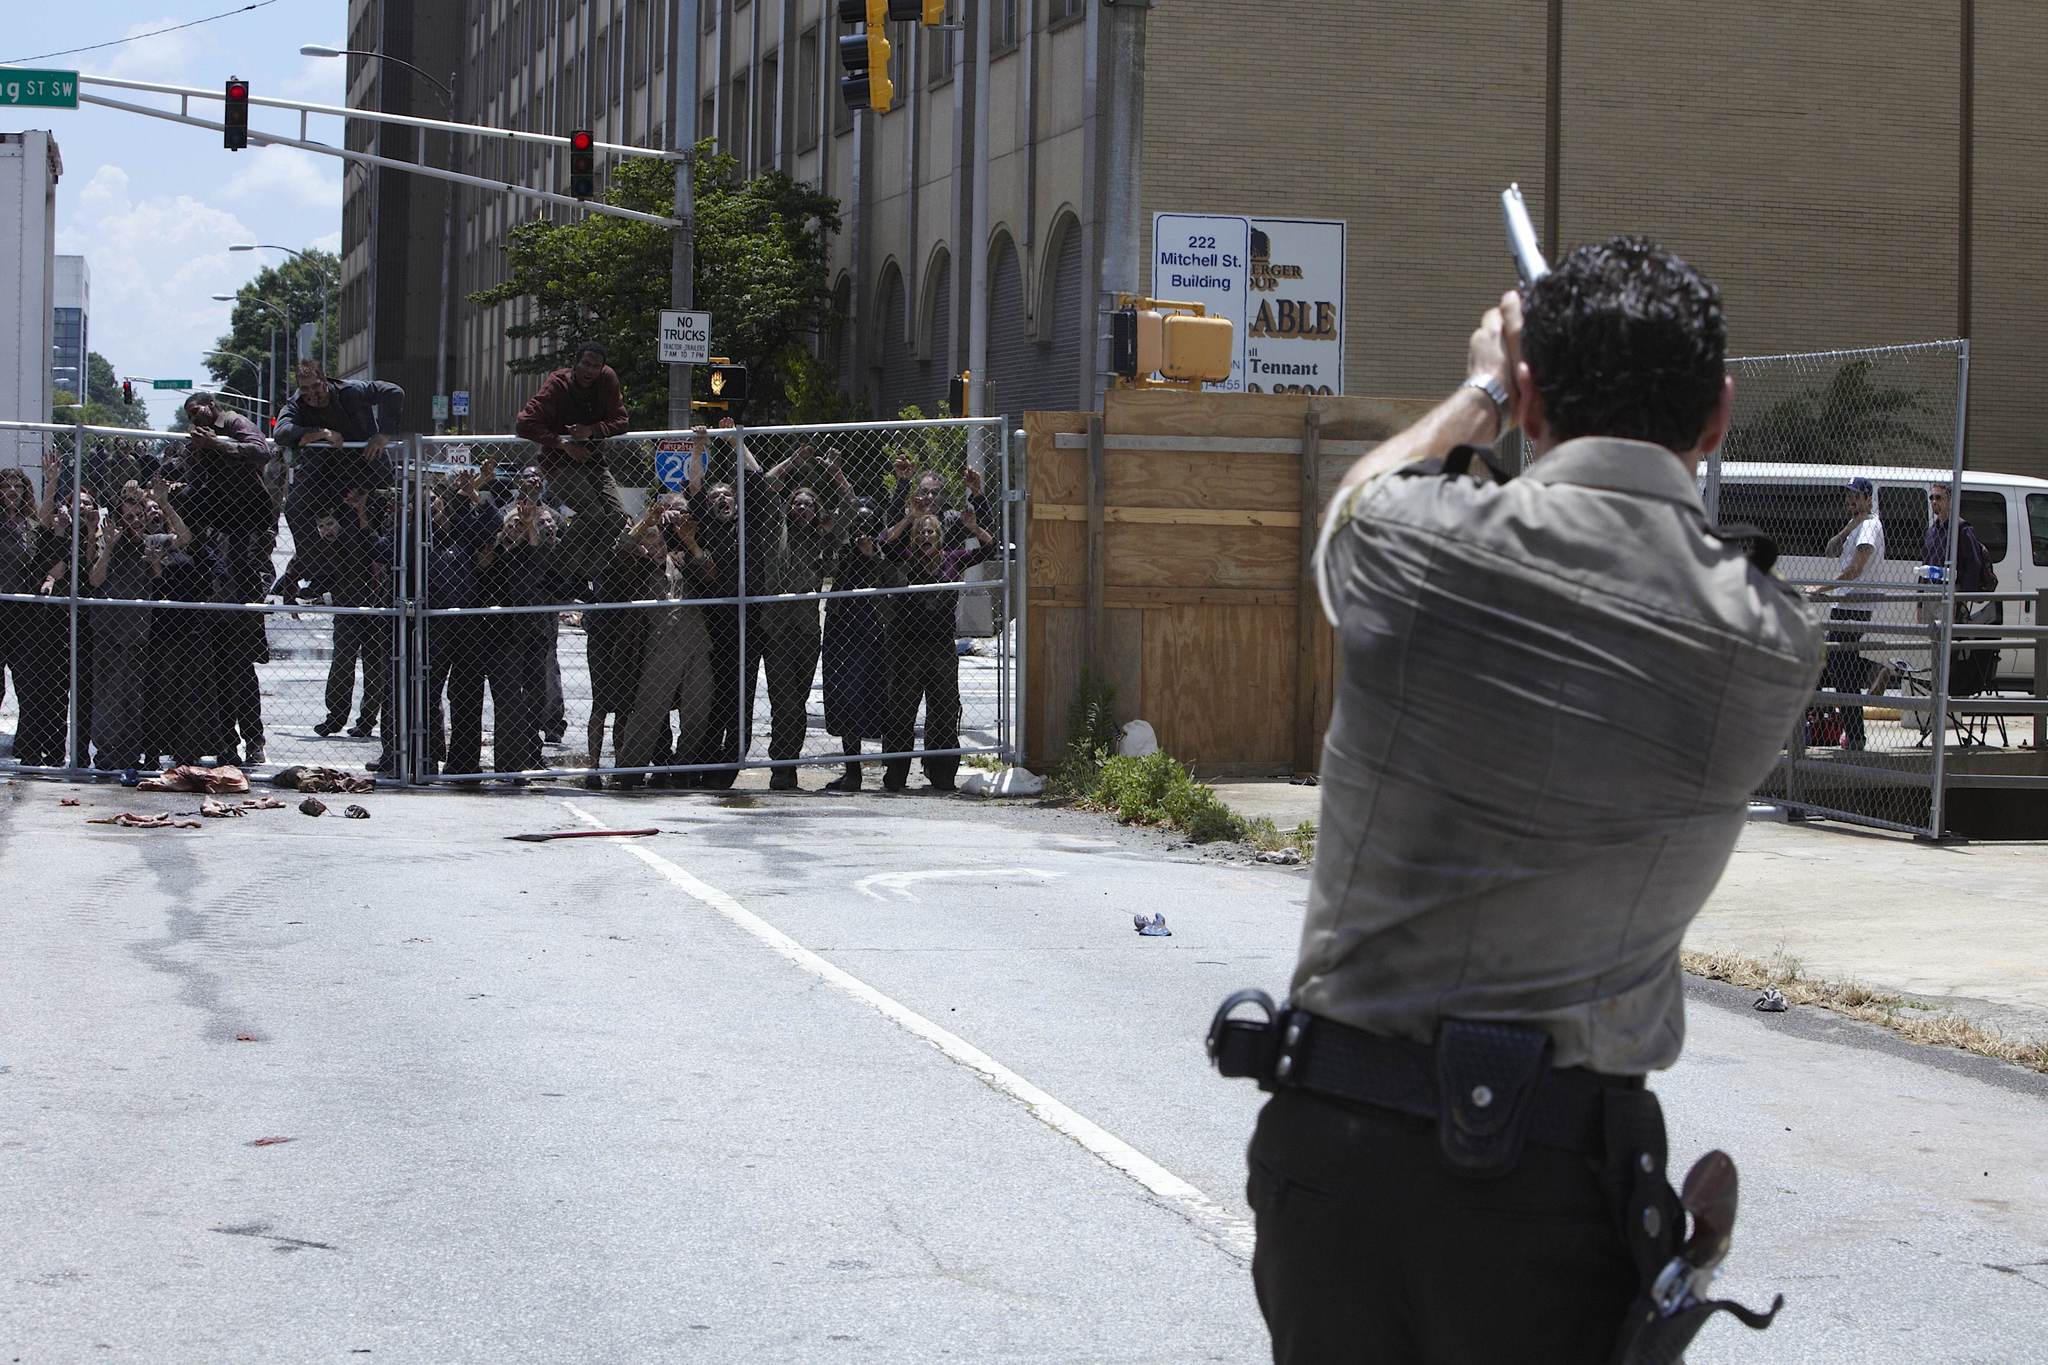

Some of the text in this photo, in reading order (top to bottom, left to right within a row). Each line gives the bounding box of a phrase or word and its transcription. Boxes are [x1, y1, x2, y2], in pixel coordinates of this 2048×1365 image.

[27, 80, 45, 96] ST
[52, 81, 73, 97] SW
[1188, 236, 1216, 249] 222
[1161, 252, 1242, 268] Mitchell St.
[1251, 263, 1303, 279] ERGER
[1172, 274, 1231, 291] Building
[677, 316, 693, 328] NO
[1249, 298, 1335, 336] ABLE
[664, 329, 706, 341] TRUCKS
[1250, 359, 1319, 376] Tennant
